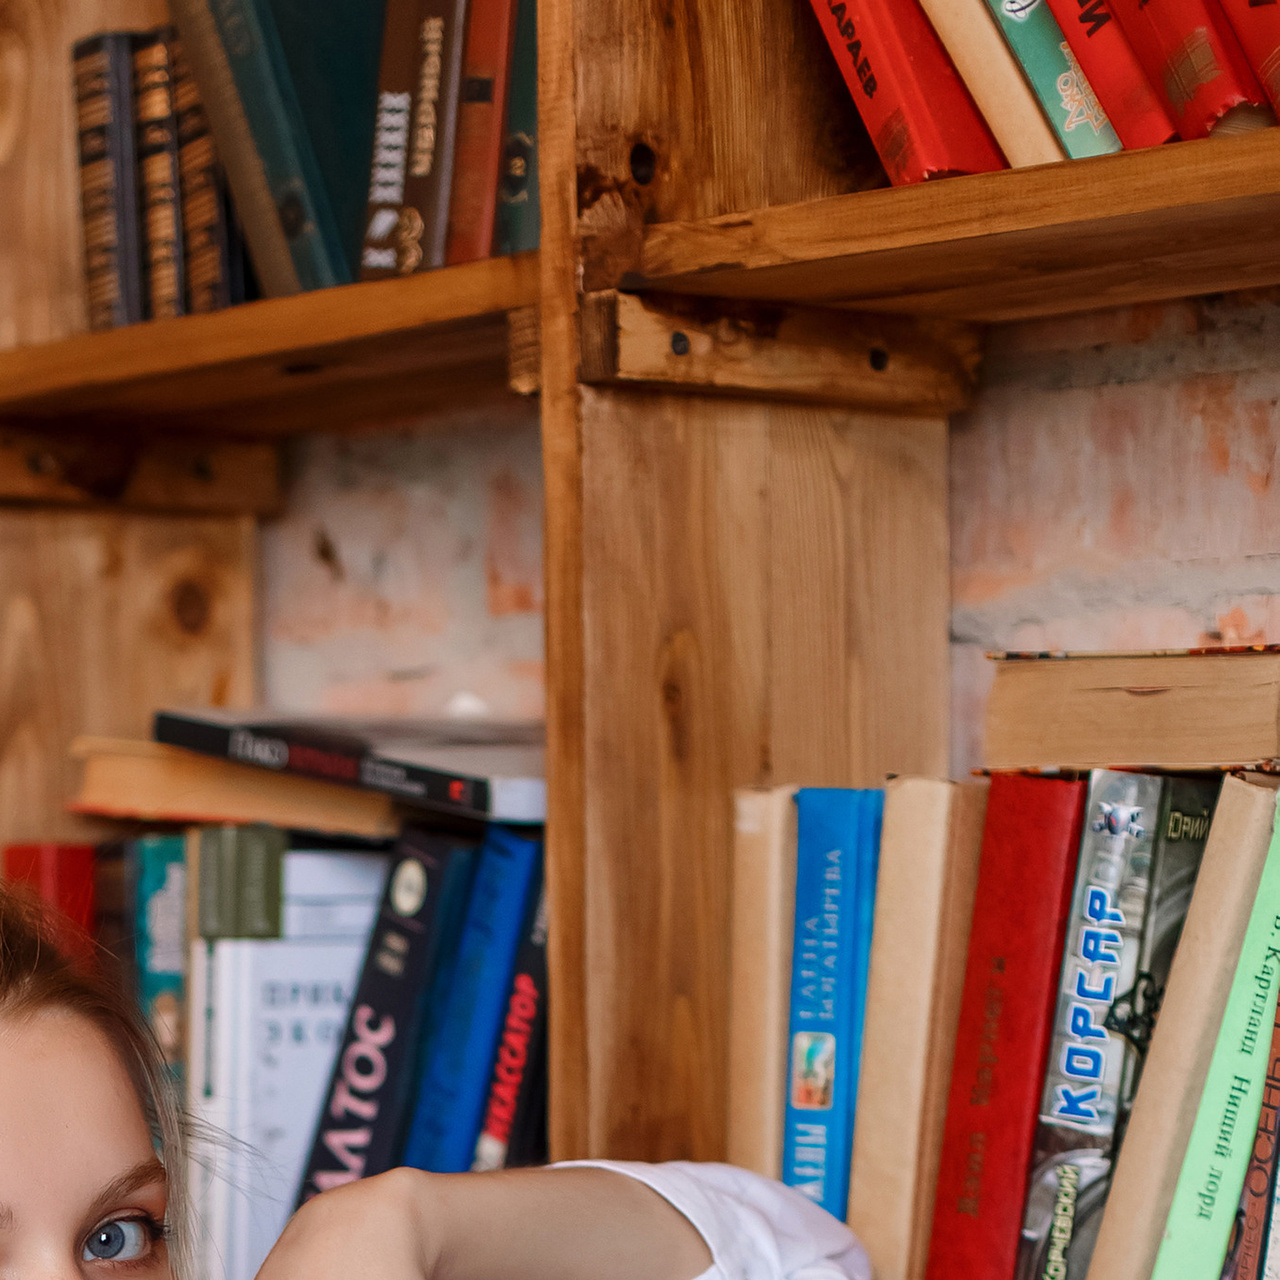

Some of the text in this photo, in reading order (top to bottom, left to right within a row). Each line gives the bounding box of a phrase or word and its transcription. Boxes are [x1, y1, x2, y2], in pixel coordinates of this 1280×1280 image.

[1051, 884, 1125, 1121] КОРСАР
[1197, 945, 1280, 1222] Картланд Нищий лорд
